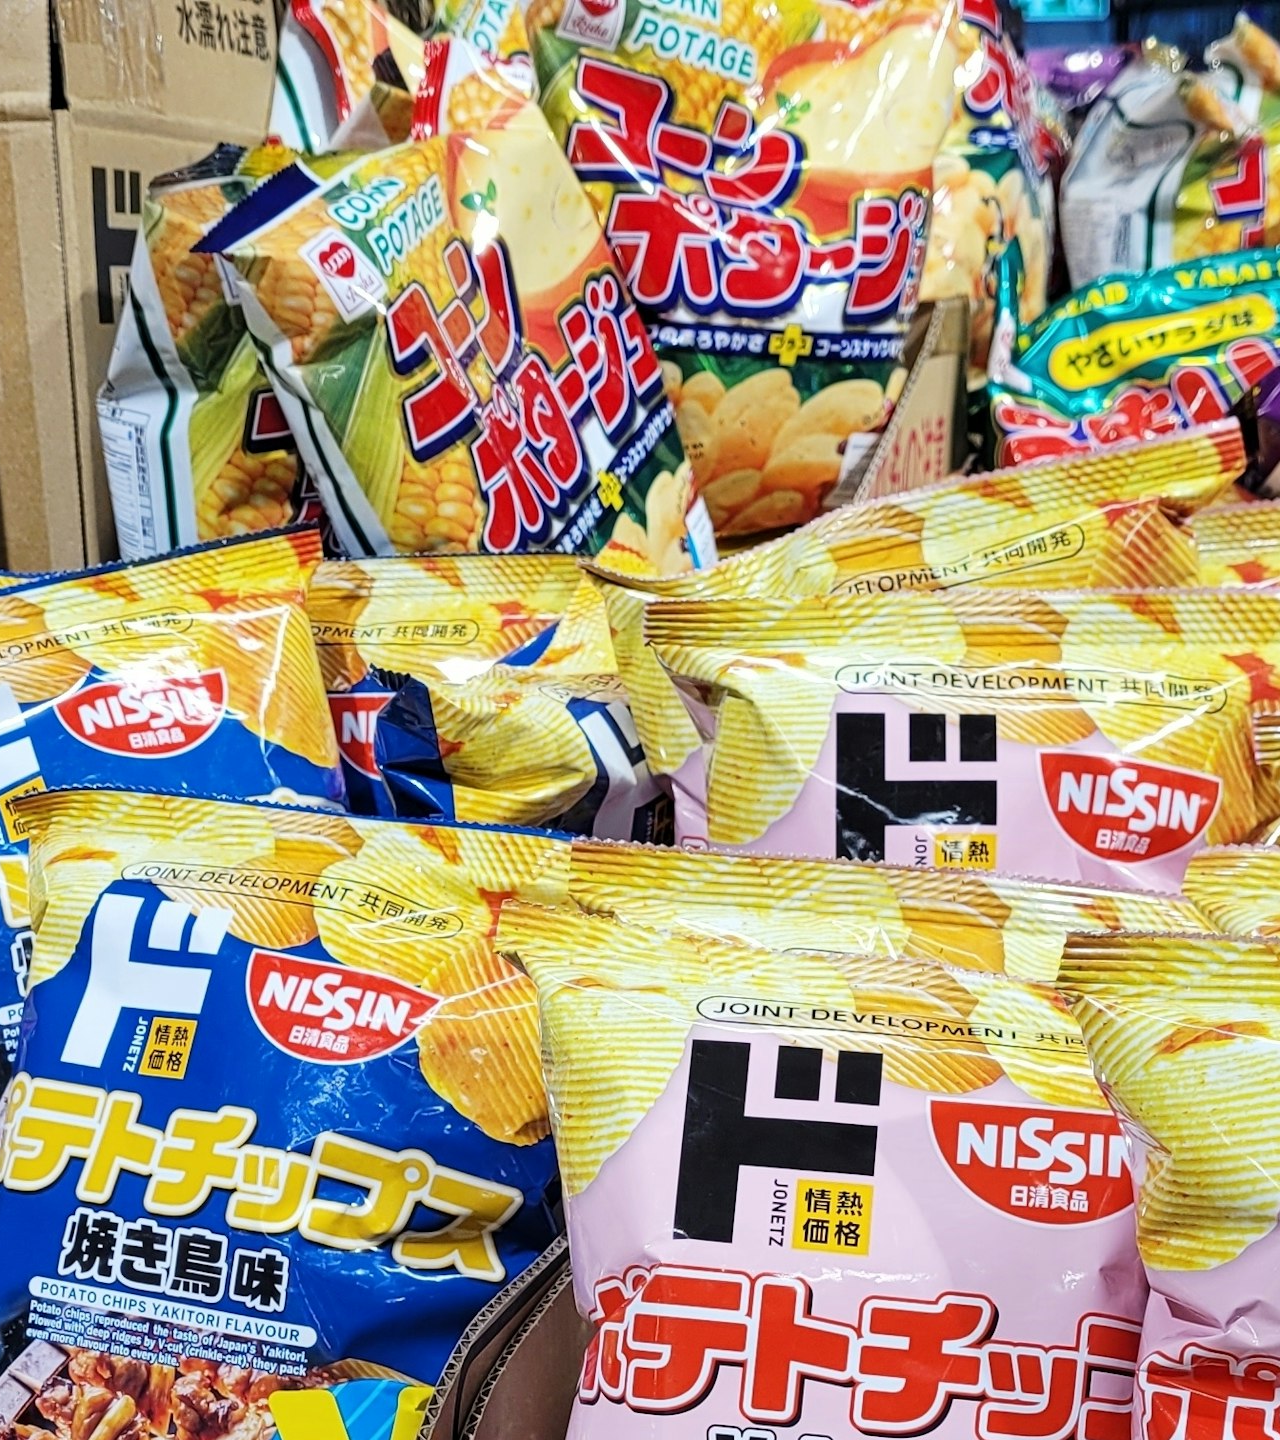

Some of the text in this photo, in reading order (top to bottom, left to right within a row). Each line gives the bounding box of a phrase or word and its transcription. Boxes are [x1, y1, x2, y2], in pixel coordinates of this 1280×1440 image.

[632, 18, 755, 79] POTAGE
[568, 56, 798, 210] コーン
[372, 181, 443, 268] POTAGE
[77, 676, 220, 738] NISSIN
[128, 726, 186, 750] 日清食品
[1057, 766, 1202, 835] NISSIN
[1094, 829, 1151, 855] 日清食品
[131, 864, 451, 932] JOINT DEVELOPMENT 共同開発
[258, 971, 412, 1037] NISSIN
[711, 999, 1019, 1042] JOINT DEVELOPMENT
[122, 1015, 150, 1074] JONETZ
[288, 1024, 351, 1056] 日清食品
[956, 1117, 1133, 1186] NISSIN
[767, 1178, 788, 1248] JONETZ
[1009, 1185, 1090, 1214] 日清食品
[56, 1207, 291, 1312] 焼き鳥味
[39, 1282, 301, 1340] POTATO CHIPS YAKITORI FLAVOUR
